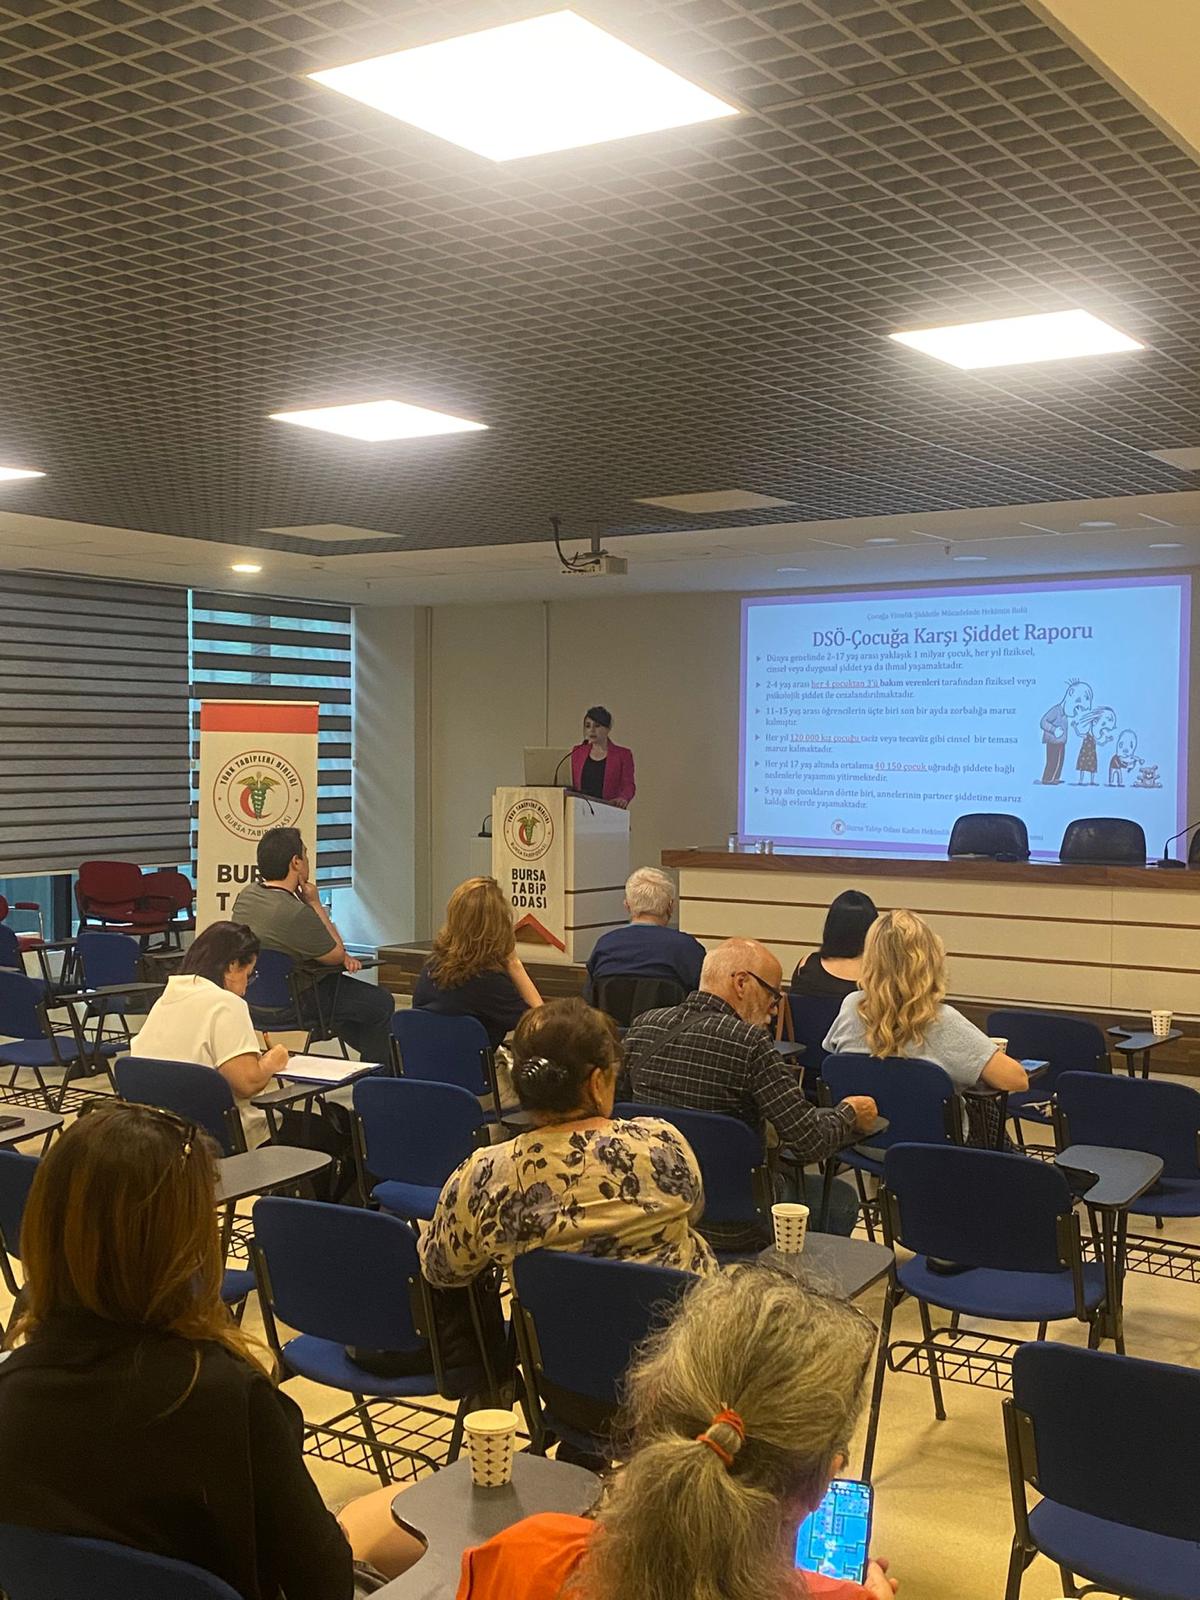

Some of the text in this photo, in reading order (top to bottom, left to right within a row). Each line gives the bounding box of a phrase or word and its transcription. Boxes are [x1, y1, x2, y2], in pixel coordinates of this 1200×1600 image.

[813, 623, 1093, 649] DSÖ-Çocuğa Karşı Şiddet Raporu
[766, 647, 1035, 663] Dünya genelinde 2-17 yaş arası yaklaşık 1 milyar çocuk, her yıl fiziksel,
[224, 813, 246, 833] BURSA
[512, 868, 546, 882] BURSA
[511, 895, 547, 909] ODASI
